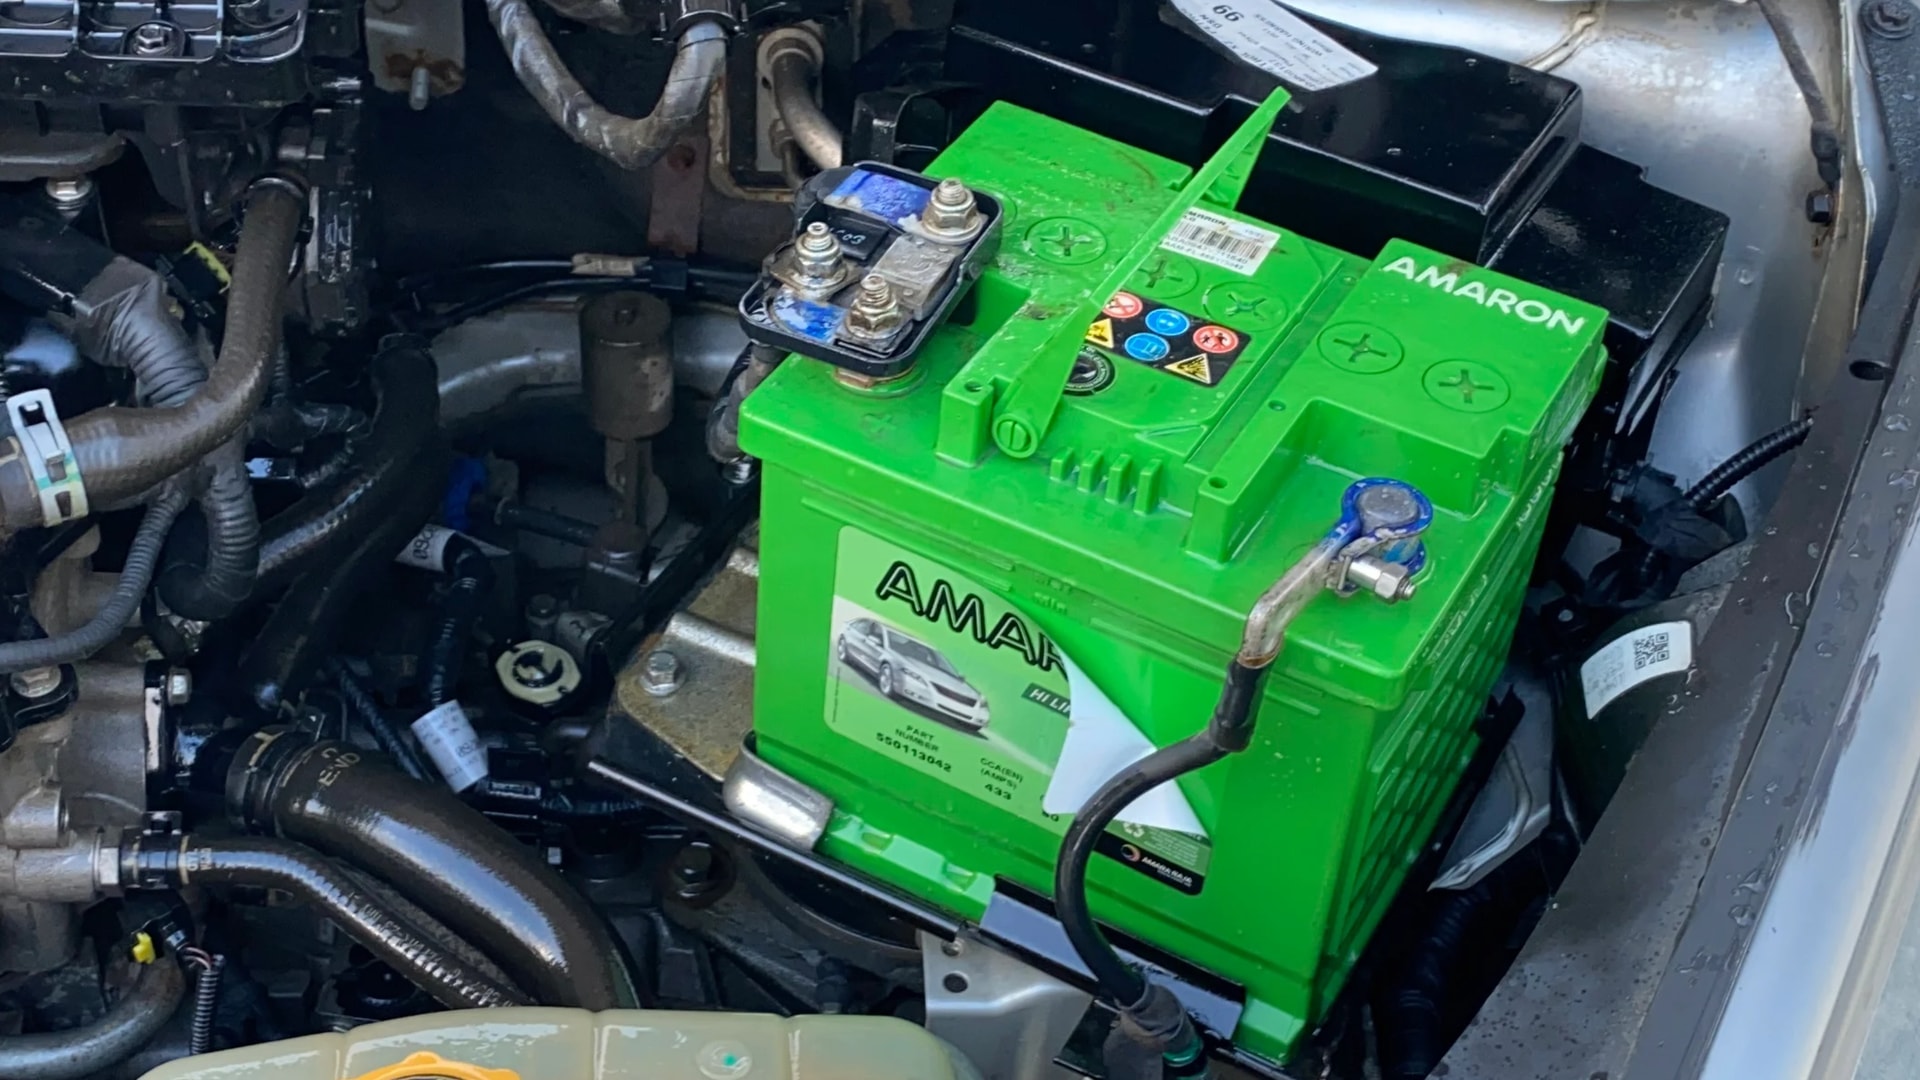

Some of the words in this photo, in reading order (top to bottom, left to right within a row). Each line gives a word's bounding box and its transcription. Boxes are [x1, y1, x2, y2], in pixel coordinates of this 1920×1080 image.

[1382, 256, 1588, 335] AMARON
[1029, 688, 1050, 703] HI
[895, 729, 939, 752] NUMBER
[906, 725, 935, 741] PART
[876, 732, 952, 773] 550113042
[984, 783, 1012, 801] 433
